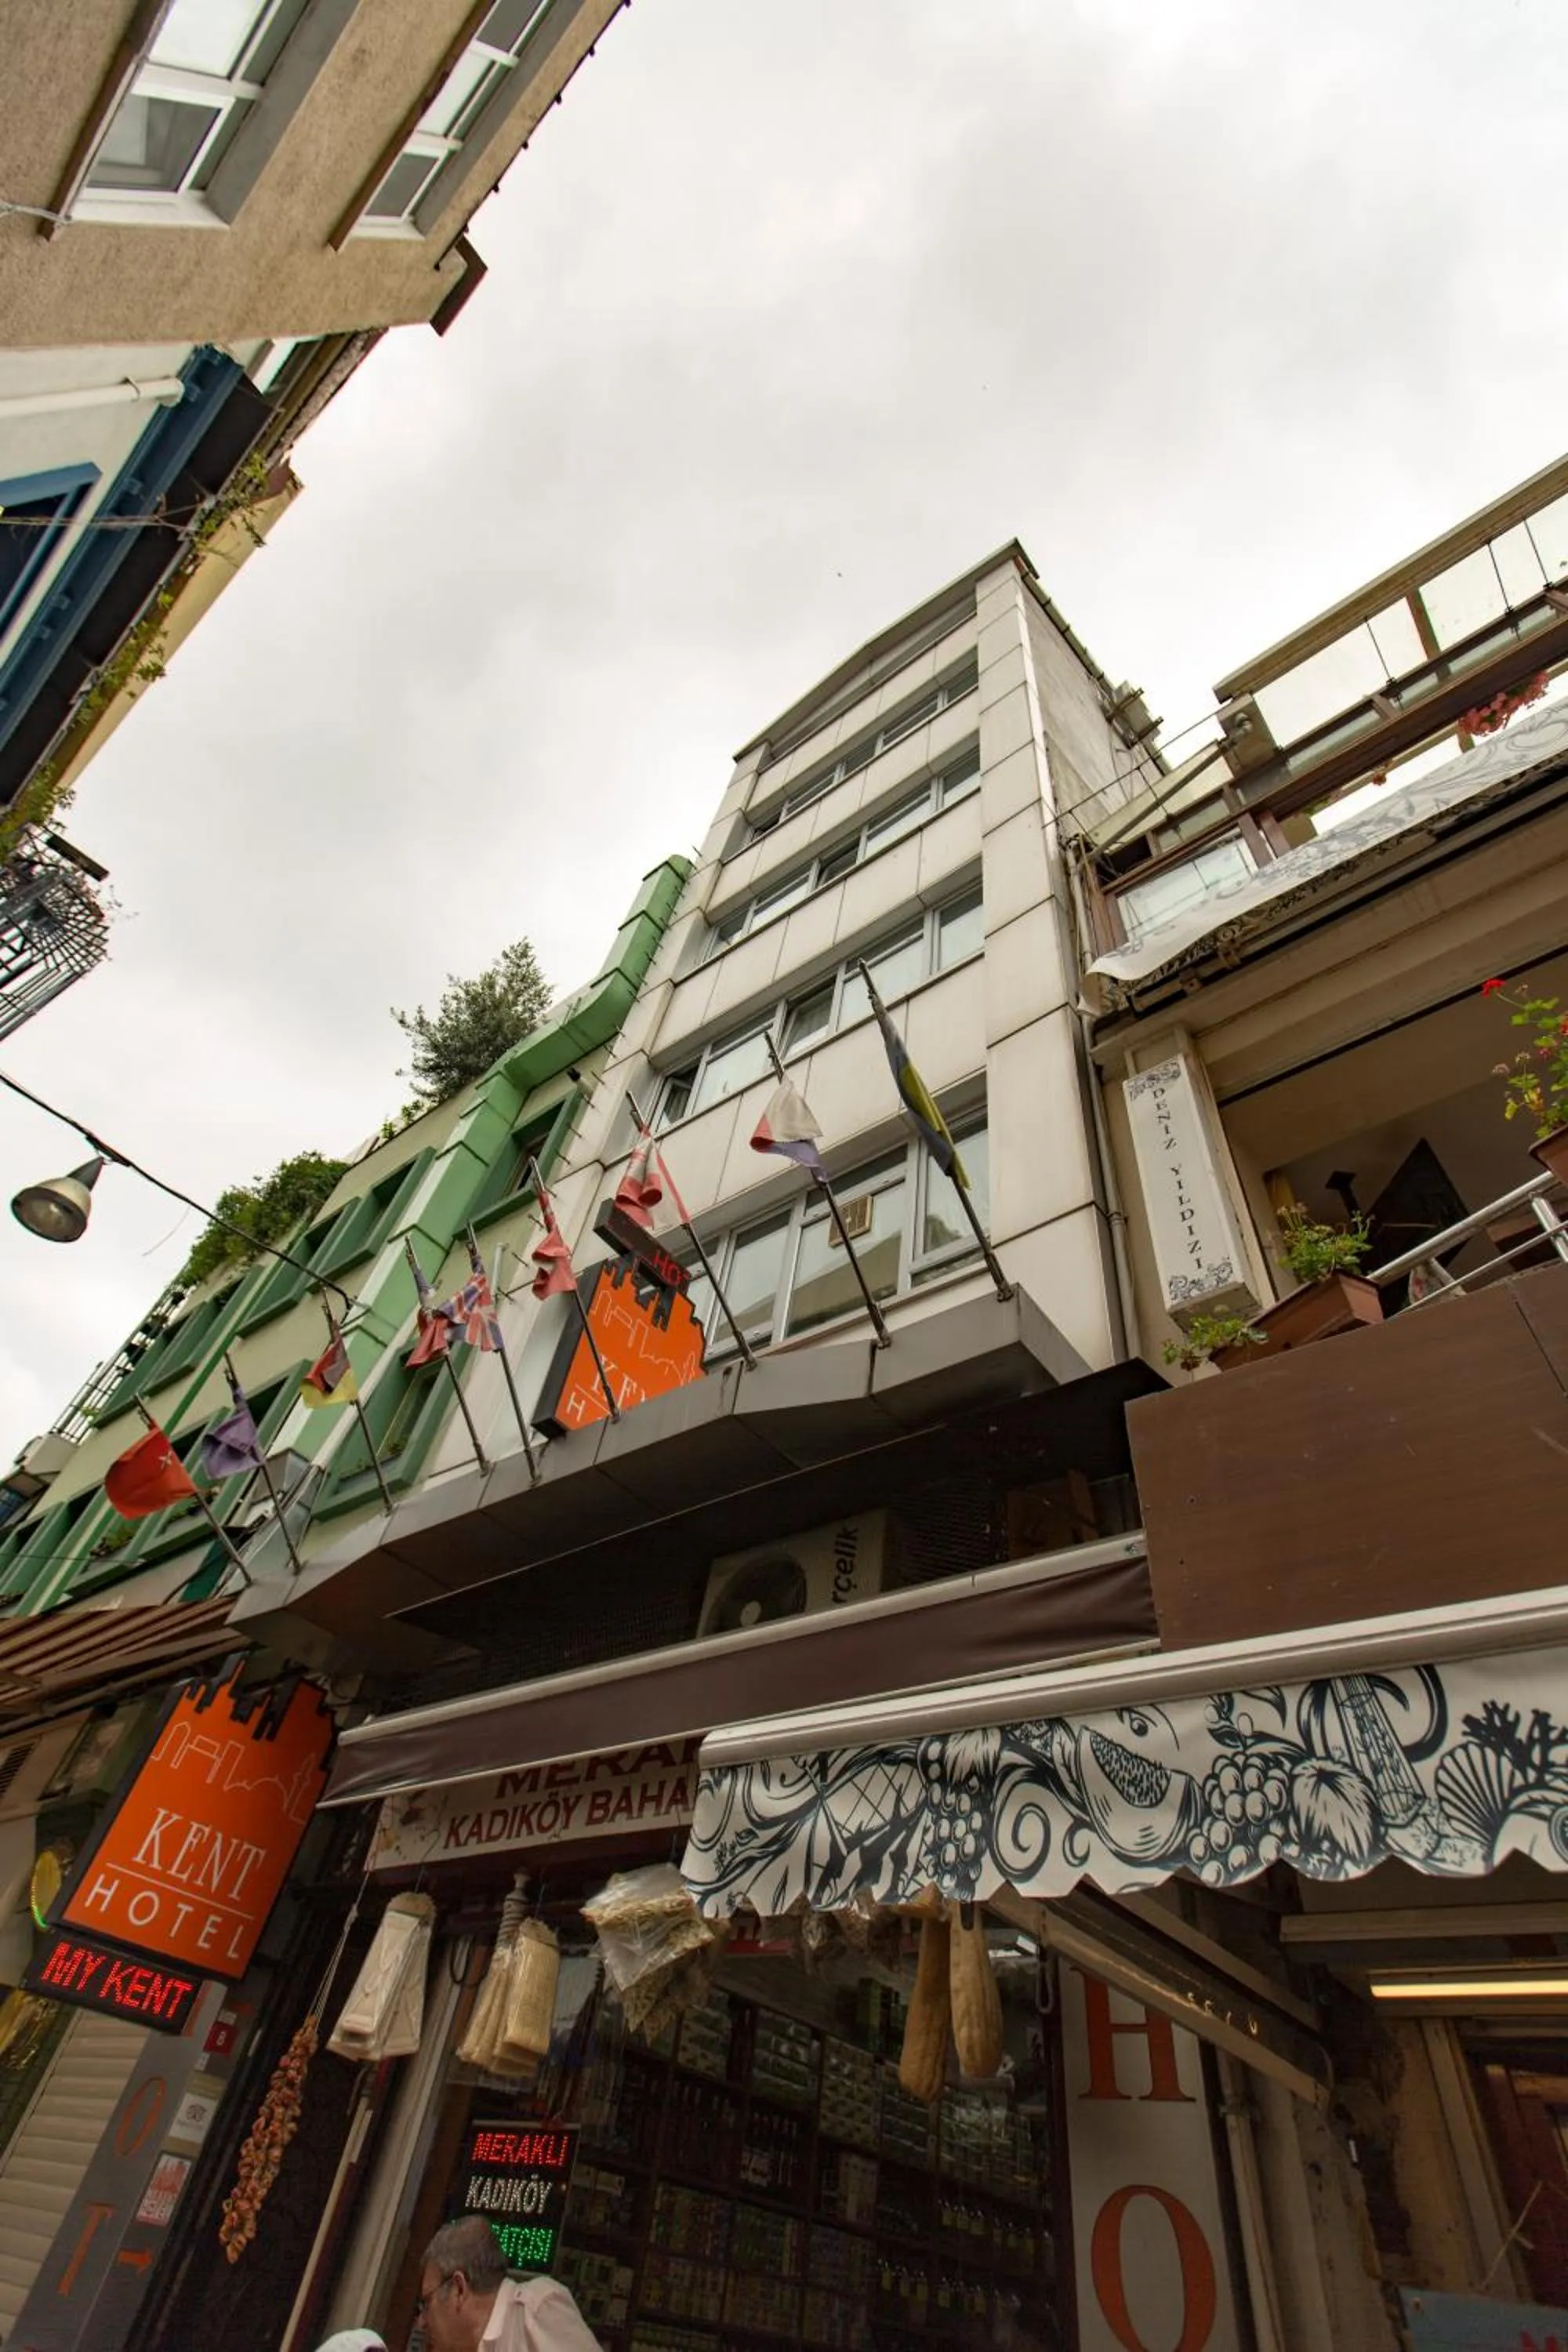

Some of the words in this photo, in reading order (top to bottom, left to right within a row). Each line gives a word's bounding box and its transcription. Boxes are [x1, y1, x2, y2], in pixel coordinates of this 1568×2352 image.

[832, 1526, 859, 1604] rçelik
[443, 1788, 583, 1850] KADIKÖY
[584, 1777, 694, 1827] BAHA
[132, 1807, 266, 1902] KENT
[84, 1873, 245, 1959] HOTEL
[41, 1941, 103, 1991] MY
[100, 1960, 194, 2020] KENT
[471, 2132, 569, 2167] MERAKLI
[465, 2173, 553, 2215] KADIKÖY
